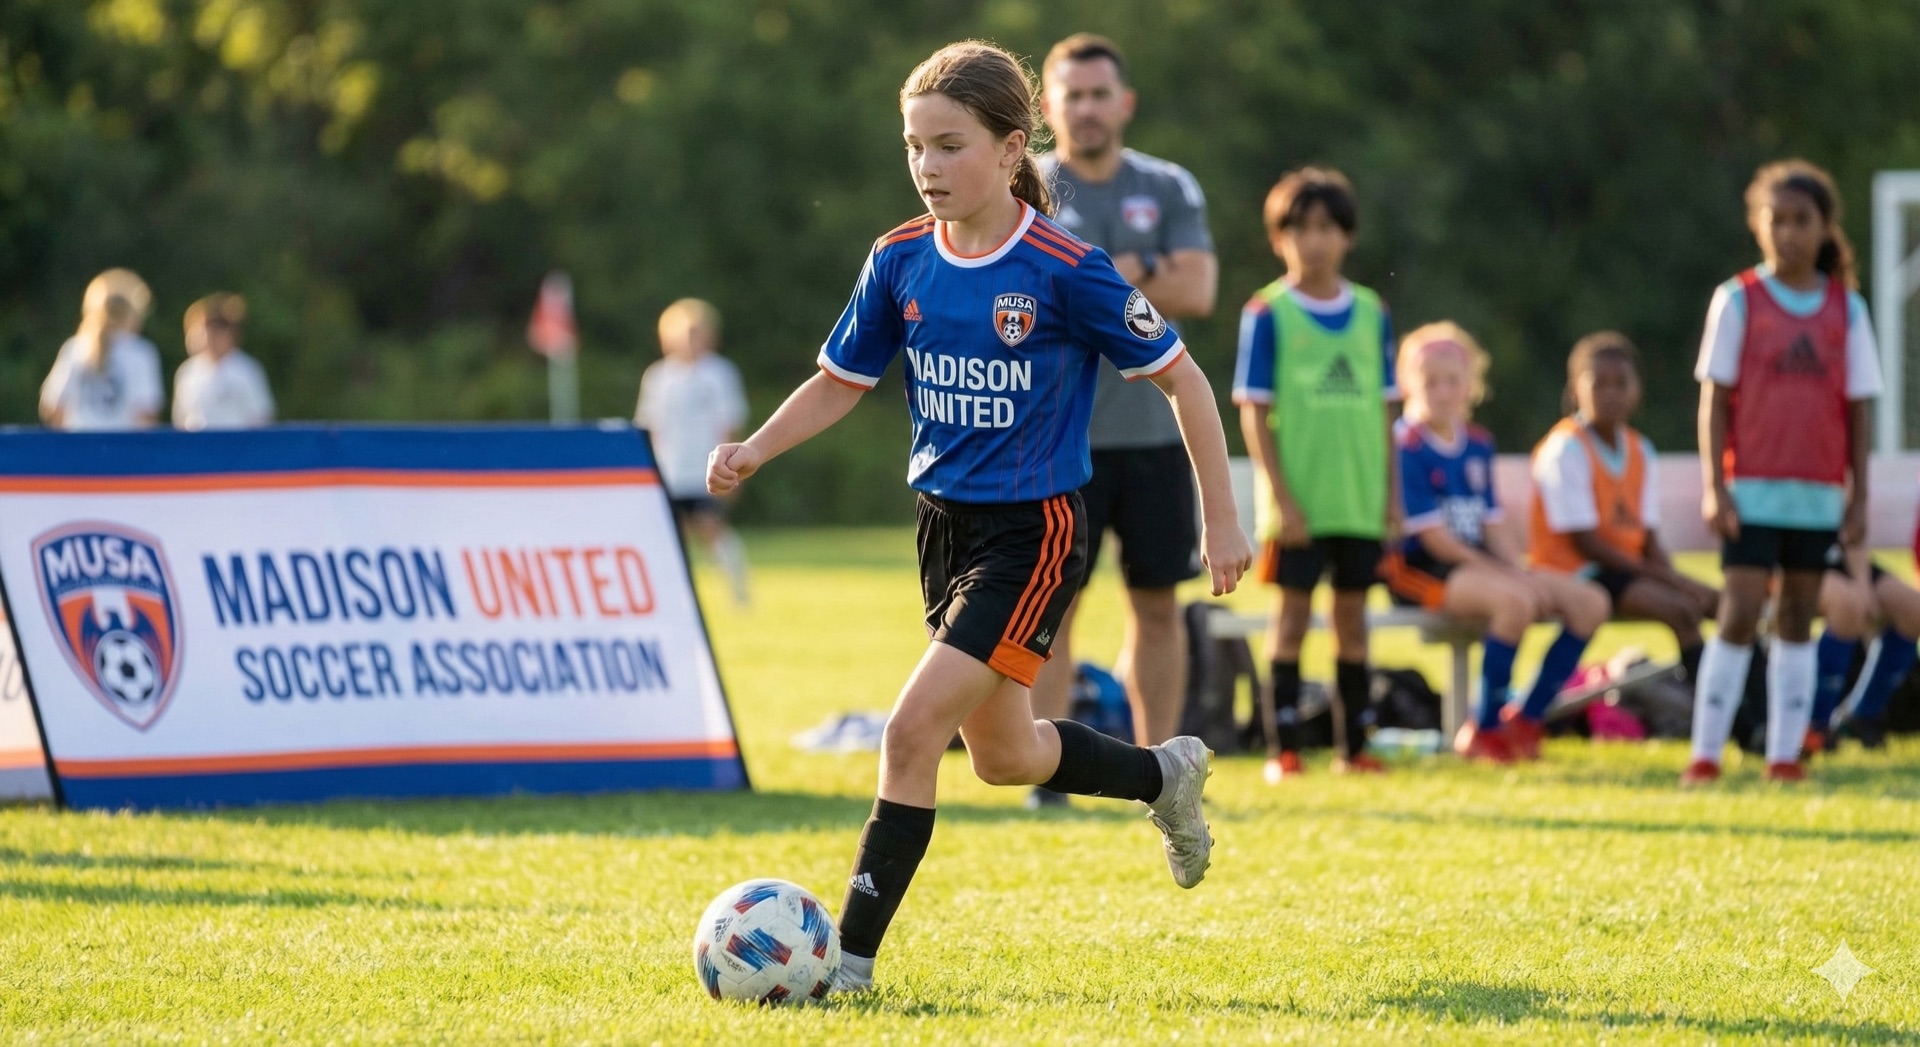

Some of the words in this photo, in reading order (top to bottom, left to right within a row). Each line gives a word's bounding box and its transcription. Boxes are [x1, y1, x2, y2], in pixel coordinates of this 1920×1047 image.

[997, 296, 1033, 311] MUSA
[917, 385, 1015, 428] UNITED
[42, 535, 162, 588] MUSA
[201, 548, 456, 628] MADISON
[461, 546, 657, 619] UNITED
[235, 641, 402, 704] SOCCER
[411, 638, 670, 696] ASSOCIATION
